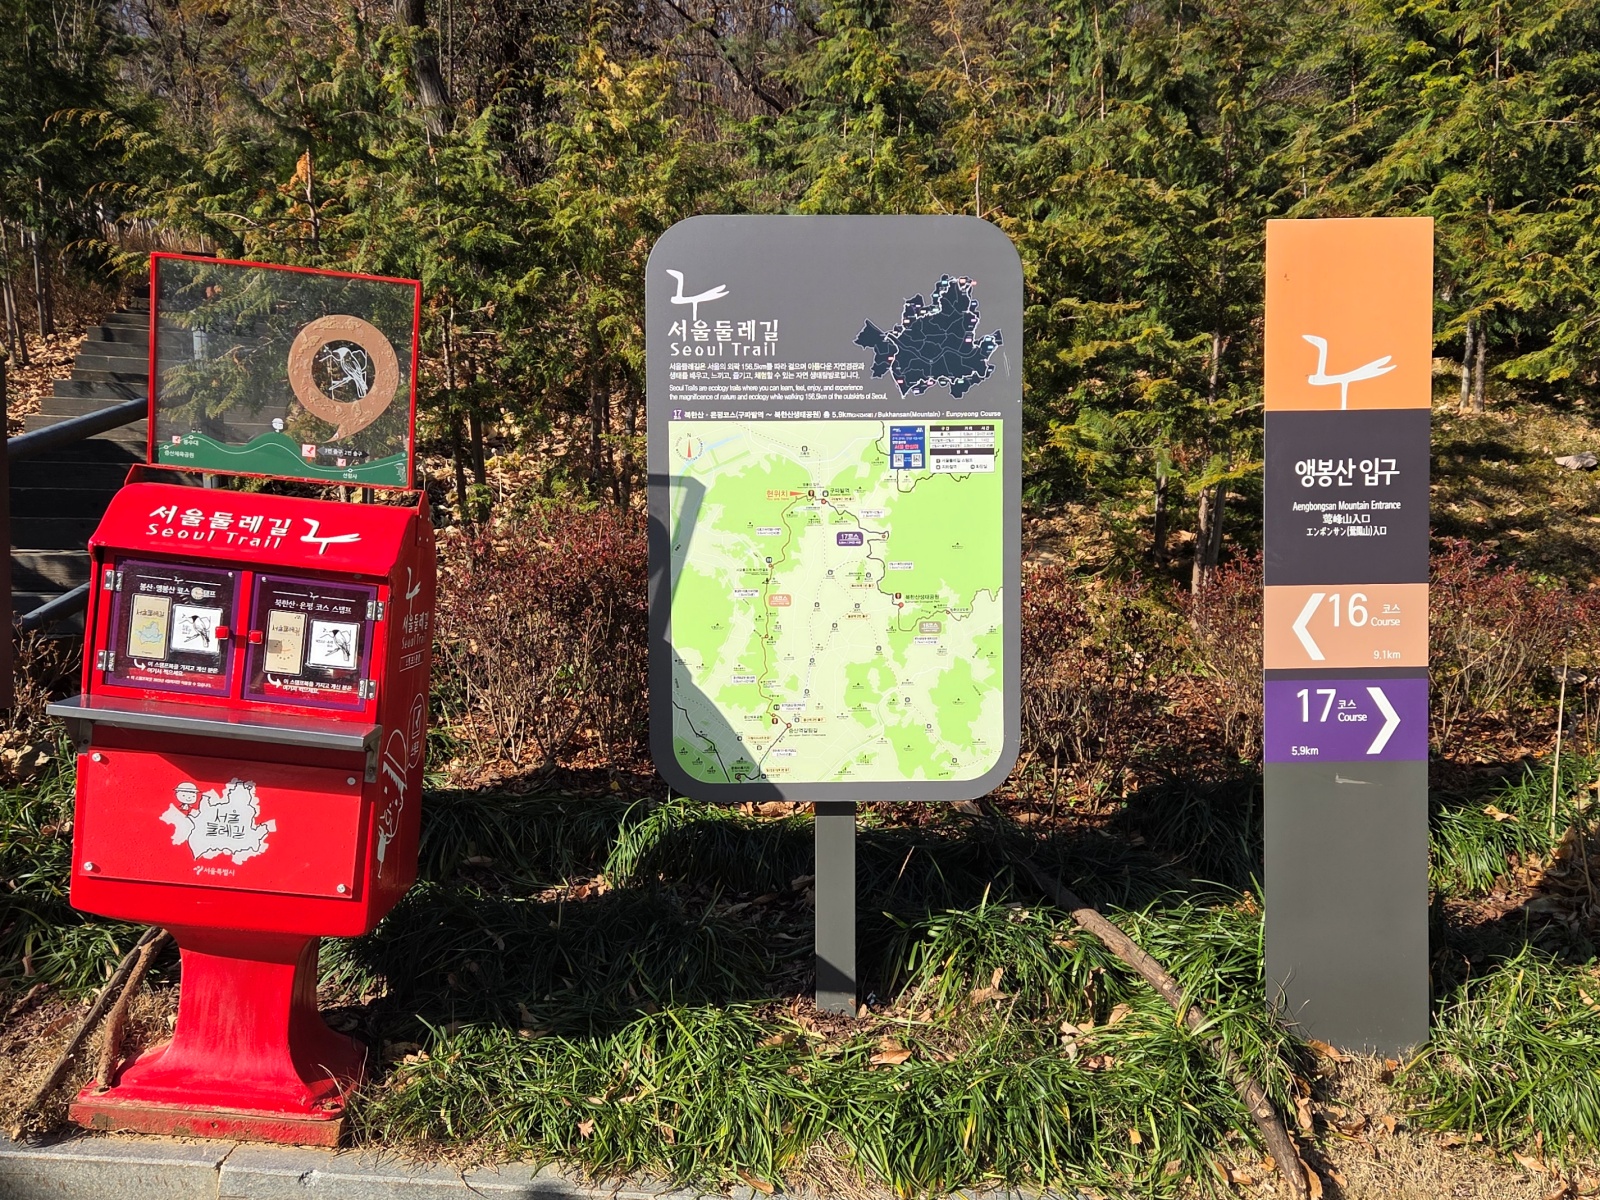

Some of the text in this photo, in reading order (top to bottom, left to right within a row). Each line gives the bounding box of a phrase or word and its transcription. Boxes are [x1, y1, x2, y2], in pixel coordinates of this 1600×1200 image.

[668, 319, 779, 342] 서울둘레길
[670, 342, 776, 356] Seoul Trail
[669, 362, 706, 371] 서울둘레길은
[707, 362, 726, 371] 서울의
[774, 362, 787, 371] 따라
[788, 362, 807, 371] 걸으며
[807, 362, 833, 371] 아름다운
[833, 362, 865, 371] 자연경관과
[669, 371, 688, 380] 생태를
[754, 371, 773, 380] 체험할
[774, 371, 781, 380] 수
[782, 371, 795, 380] 있는
[796, 371, 808, 380] 자연
[669, 384, 684, 392] Seoul
[685, 384, 698, 392] Trails
[699, 384, 707, 392] are
[708, 384, 729, 392] ecology
[730, 384, 741, 392] trails
[742, 384, 758, 392] where
[759, 384, 769, 392] you
[769, 384, 779, 392] can
[807, 384, 823, 392] enjoy,
[823, 384, 834, 392] and
[835, 384, 863, 392] experience
[669, 393, 678, 401] the
[679, 393, 713, 401] magnificence
[714, 393, 719, 401] of
[720, 393, 736, 401] nature
[737, 393, 748, 401] and
[749, 393, 769, 401] ecology
[770, 393, 783, 401] while
[784, 393, 804, 401] walking
[828, 393, 833, 401] of
[834, 393, 842, 401] the
[843, 393, 865, 401] outskirts
[866, 393, 870, 401] of
[684, 411, 704, 419] 북한산
[878, 410, 940, 418] Bukhansan(Mountain)
[946, 410, 979, 418] Eunpyeong
[980, 410, 1002, 418] Course
[1294, 457, 1401, 488] 앵봉산 입구
[1292, 499, 1402, 513] Aengbongsan Mountain Entrance
[149, 505, 292, 537] 서울둘레길
[146, 523, 282, 549] Seoul Trail
[177, 587, 190, 595] 코스
[315, 604, 330, 612] 코스
[331, 606, 352, 614] 스탬프
[1329, 592, 1401, 627] 16 코스
[402, 611, 430, 635] 서울둘레길
[1371, 617, 1401, 626] Course
[401, 634, 416, 650] Seoul
[1373, 650, 1401, 660] 9.1km
[1297, 688, 1357, 723] 17 코스
[1338, 712, 1368, 722] Course
[1291, 746, 1319, 756] 5.9km
[214, 808, 241, 824] 서울
[206, 822, 245, 840] 둘레길
[203, 867, 236, 877] 서울특별시
